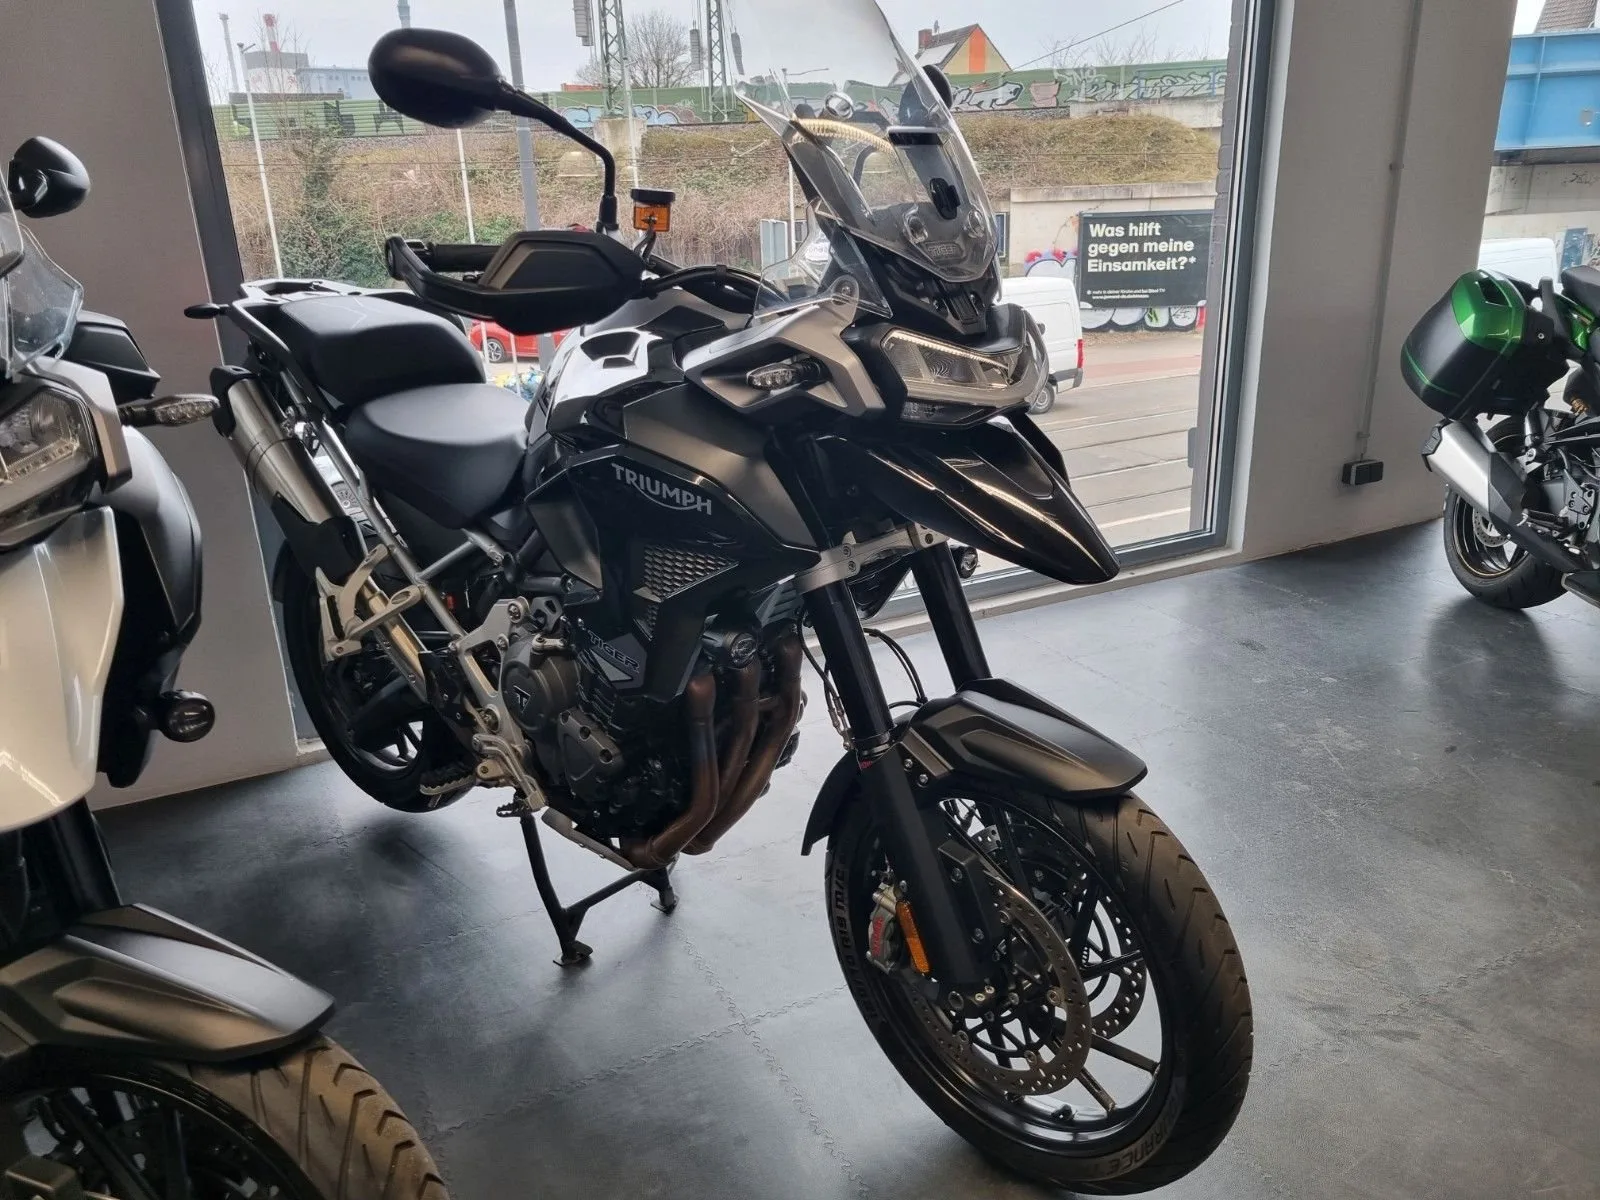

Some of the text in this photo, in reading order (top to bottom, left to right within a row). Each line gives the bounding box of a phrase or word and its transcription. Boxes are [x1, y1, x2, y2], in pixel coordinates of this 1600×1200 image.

[1089, 222, 1161, 237] Was hilft
[1087, 239, 1194, 257] gegen meine
[610, 462, 713, 516] TRIUMPH
[587, 629, 640, 674] TIGER
